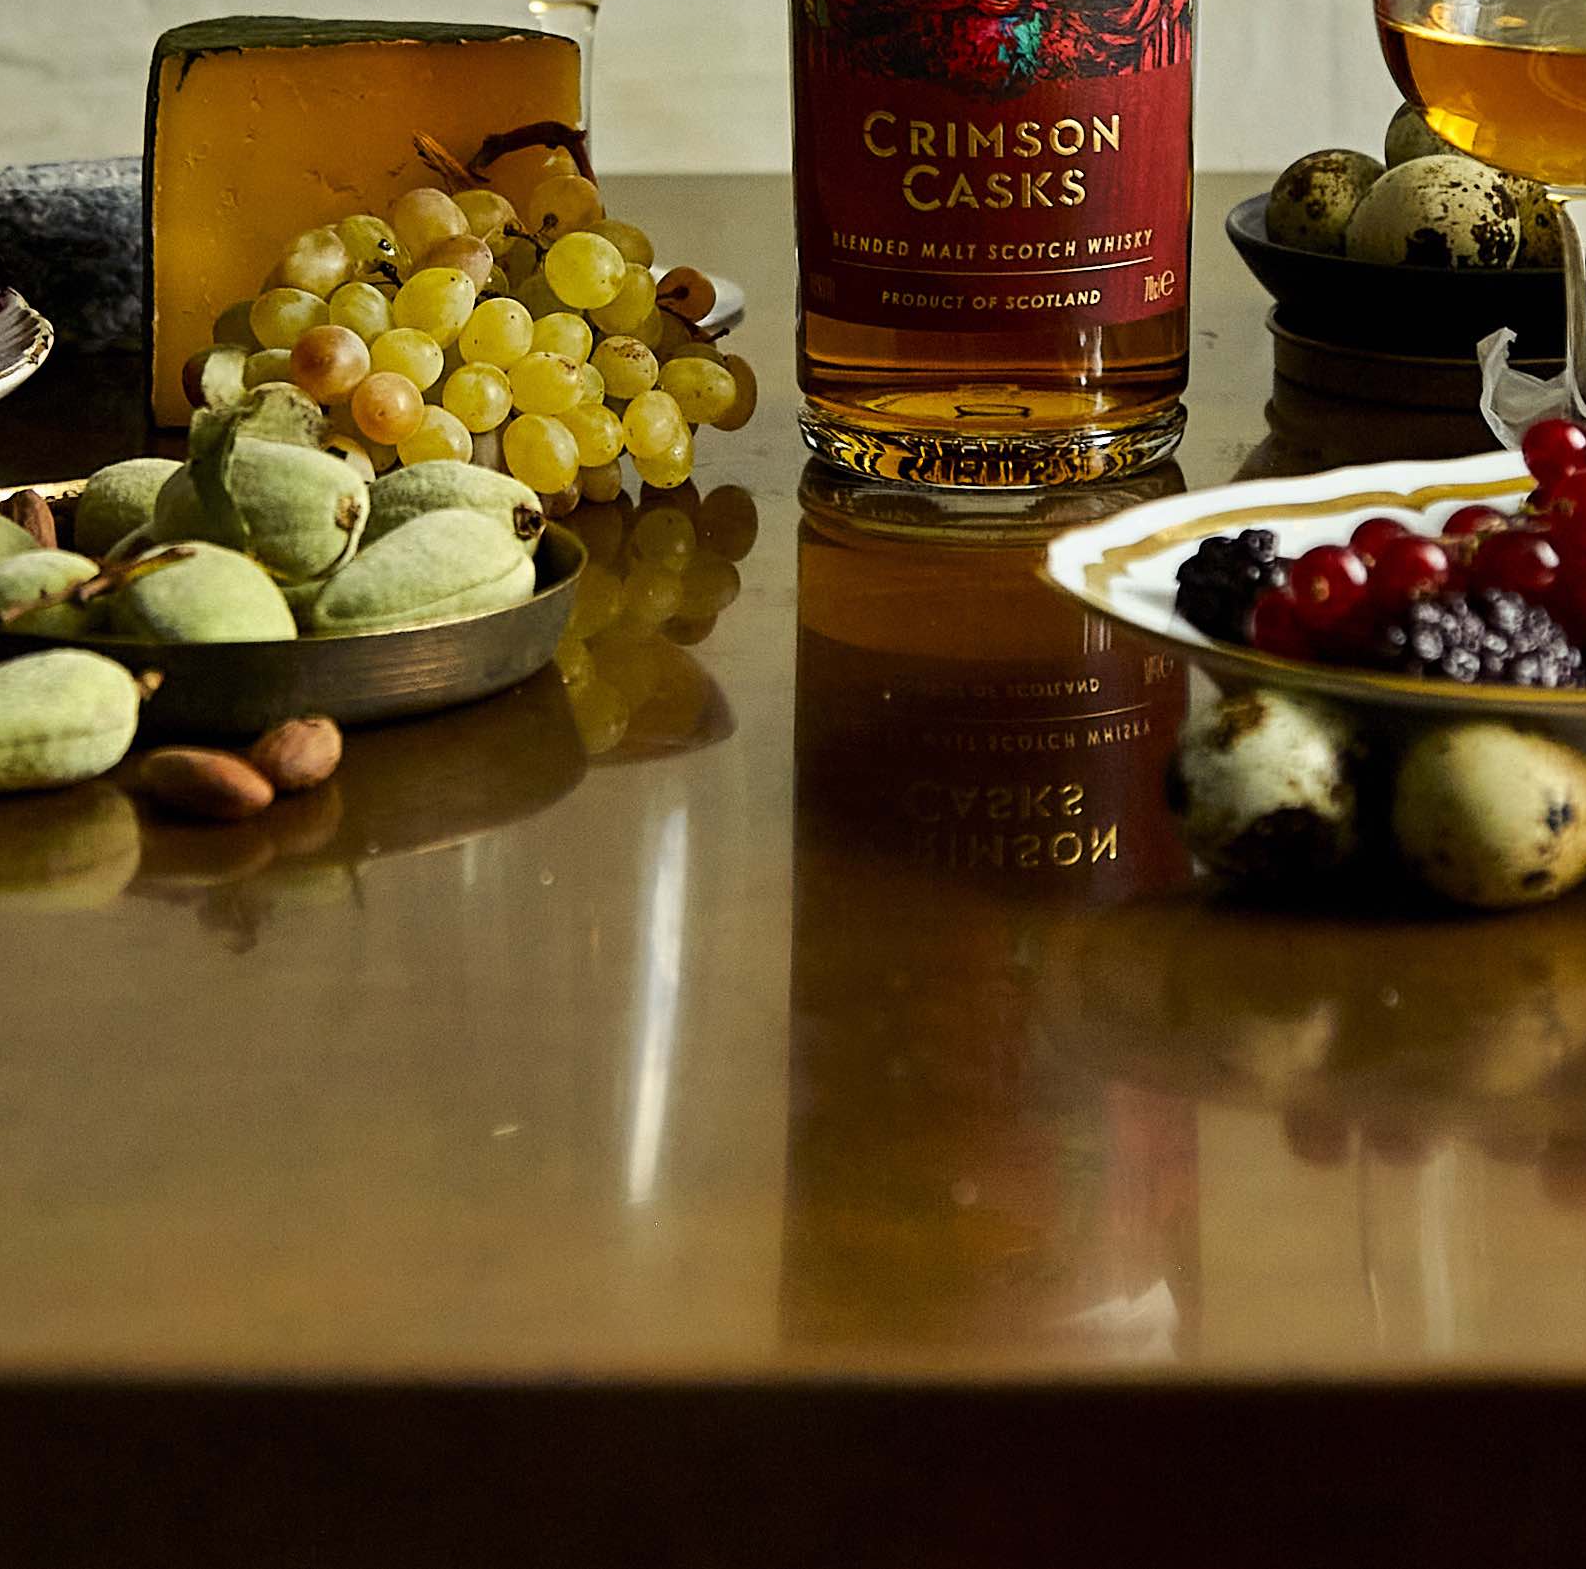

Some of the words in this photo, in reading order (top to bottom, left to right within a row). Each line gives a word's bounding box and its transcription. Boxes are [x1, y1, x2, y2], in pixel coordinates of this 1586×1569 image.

[862, 110, 1121, 159] CRIMSON
[902, 164, 1087, 212] CASKS
[832, 231, 910, 258] BLENDED
[921, 242, 977, 261] MALT
[988, 238, 1077, 261] SCOTCH
[1087, 228, 1154, 256] WHISKY
[881, 289, 966, 311] PRODUCT
[974, 295, 999, 311] OF
[1005, 288, 1102, 311] SCOTLAND
